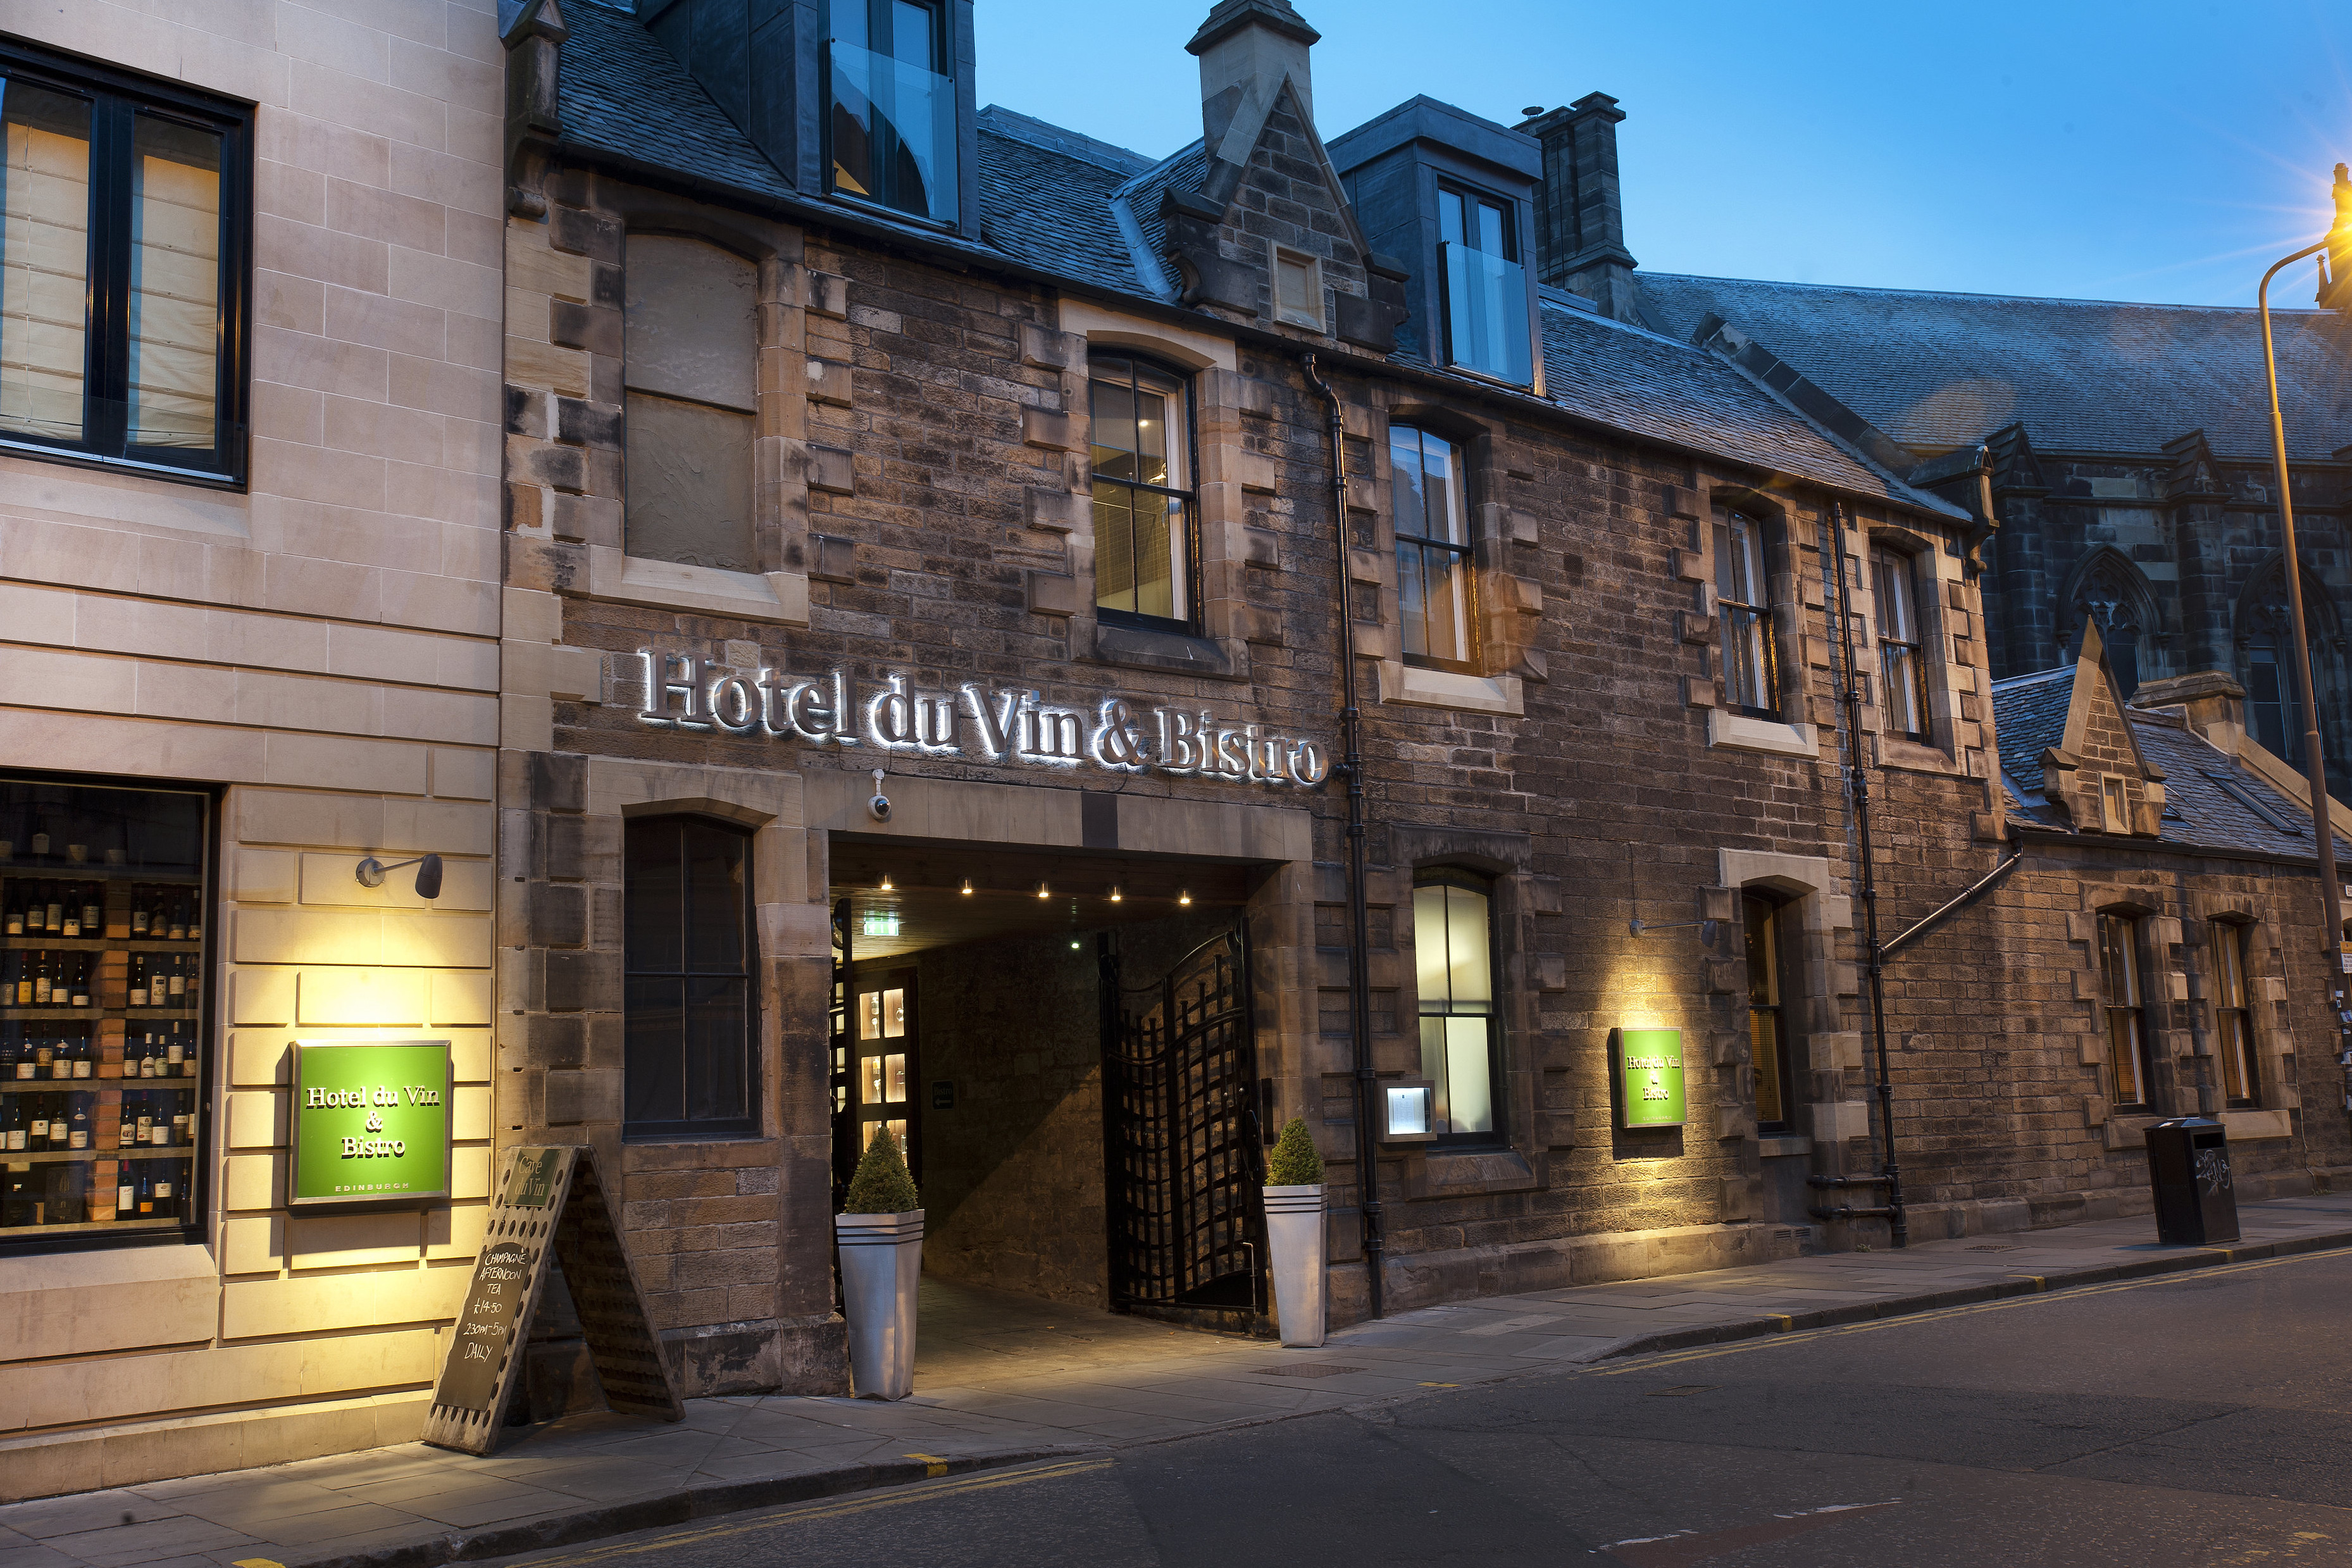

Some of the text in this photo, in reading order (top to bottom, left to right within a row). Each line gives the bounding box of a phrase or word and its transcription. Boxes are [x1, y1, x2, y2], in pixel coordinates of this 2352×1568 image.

[637, 646, 1329, 783] Hotel du Vin & Bistro
[306, 1085, 440, 1108] Hotel du Vin
[366, 1111, 383, 1132] &
[341, 1136, 406, 1159] Bistro
[519, 1156, 542, 1174] Cave
[335, 1183, 409, 1192] EDINBURGH
[514, 1177, 545, 1196] du Vin
[485, 1252, 526, 1266] CHAMPAGNE
[479, 1266, 522, 1281] AFTERNOON
[487, 1283, 501, 1295] TEA
[464, 1341, 493, 1362] DAILY
